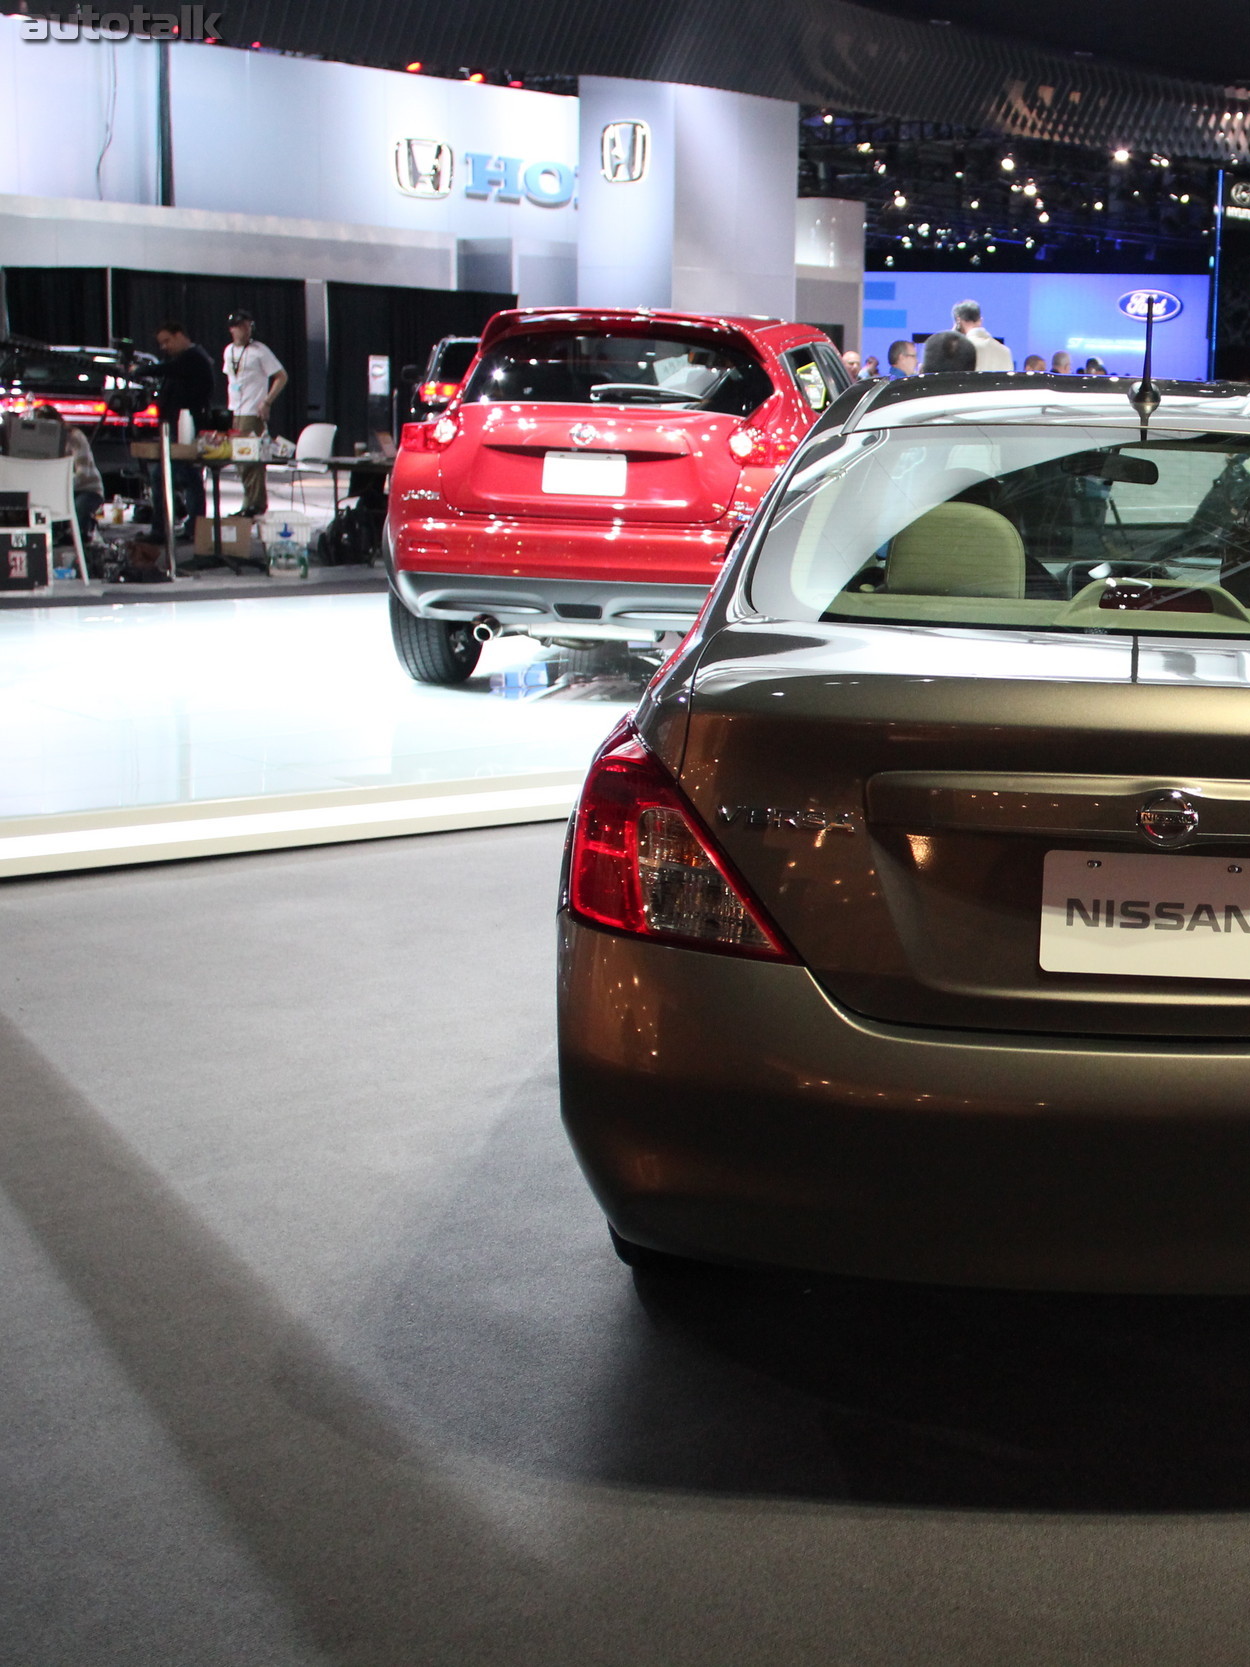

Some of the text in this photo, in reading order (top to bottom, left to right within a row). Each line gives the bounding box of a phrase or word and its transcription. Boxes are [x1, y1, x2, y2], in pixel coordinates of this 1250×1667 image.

[465, 152, 578, 210] HO
[1126, 292, 1168, 316] Fod
[717, 804, 856, 833] VERSA
